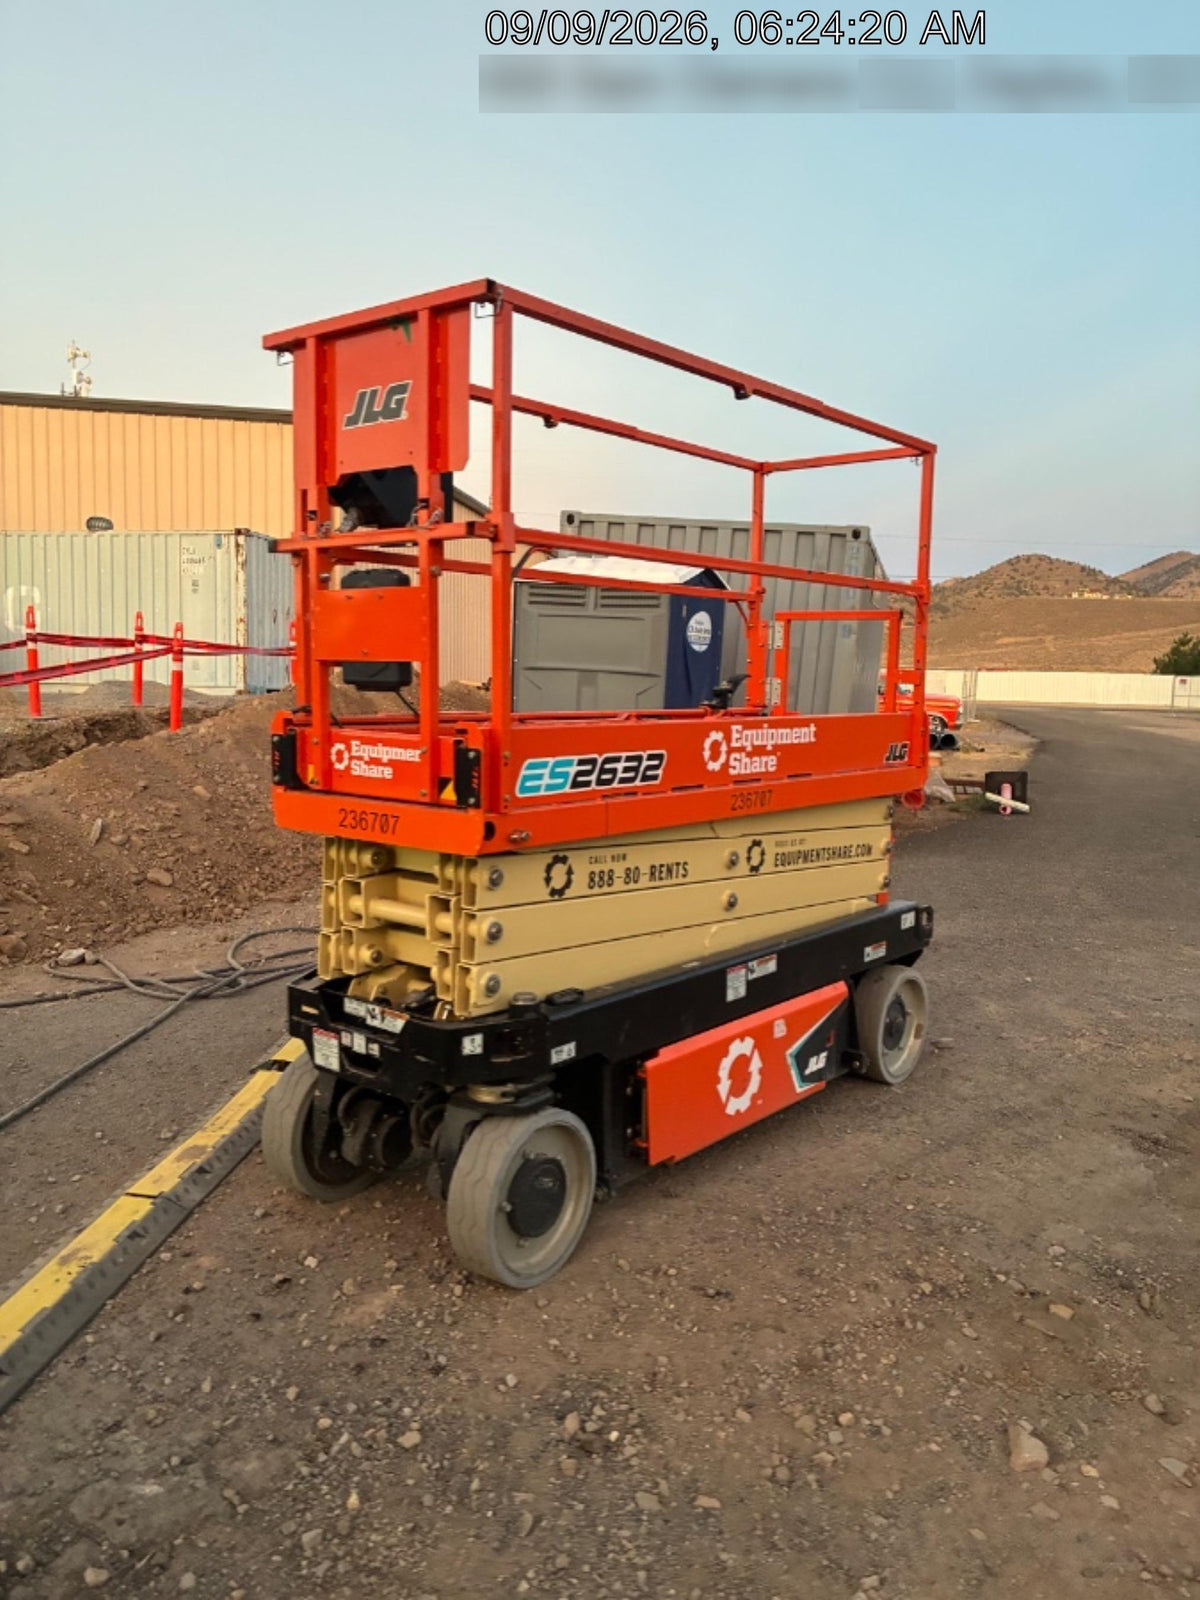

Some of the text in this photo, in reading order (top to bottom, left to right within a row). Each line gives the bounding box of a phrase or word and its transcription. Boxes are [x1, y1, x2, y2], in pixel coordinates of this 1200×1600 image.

[342, 380, 412, 430] JLG
[730, 723, 816, 751] Equipment
[728, 752, 778, 776] Share
[884, 741, 910, 765] JLG
[350, 760, 393, 779] Share
[516, 751, 666, 796] ES2632
[730, 789, 773, 811] 236707
[338, 807, 400, 835] 236707
[774, 843, 873, 868] EQUIPMENTSHARE.COM
[587, 861, 689, 890] 888-80-RENTS
[804, 1050, 829, 1076] JLG
